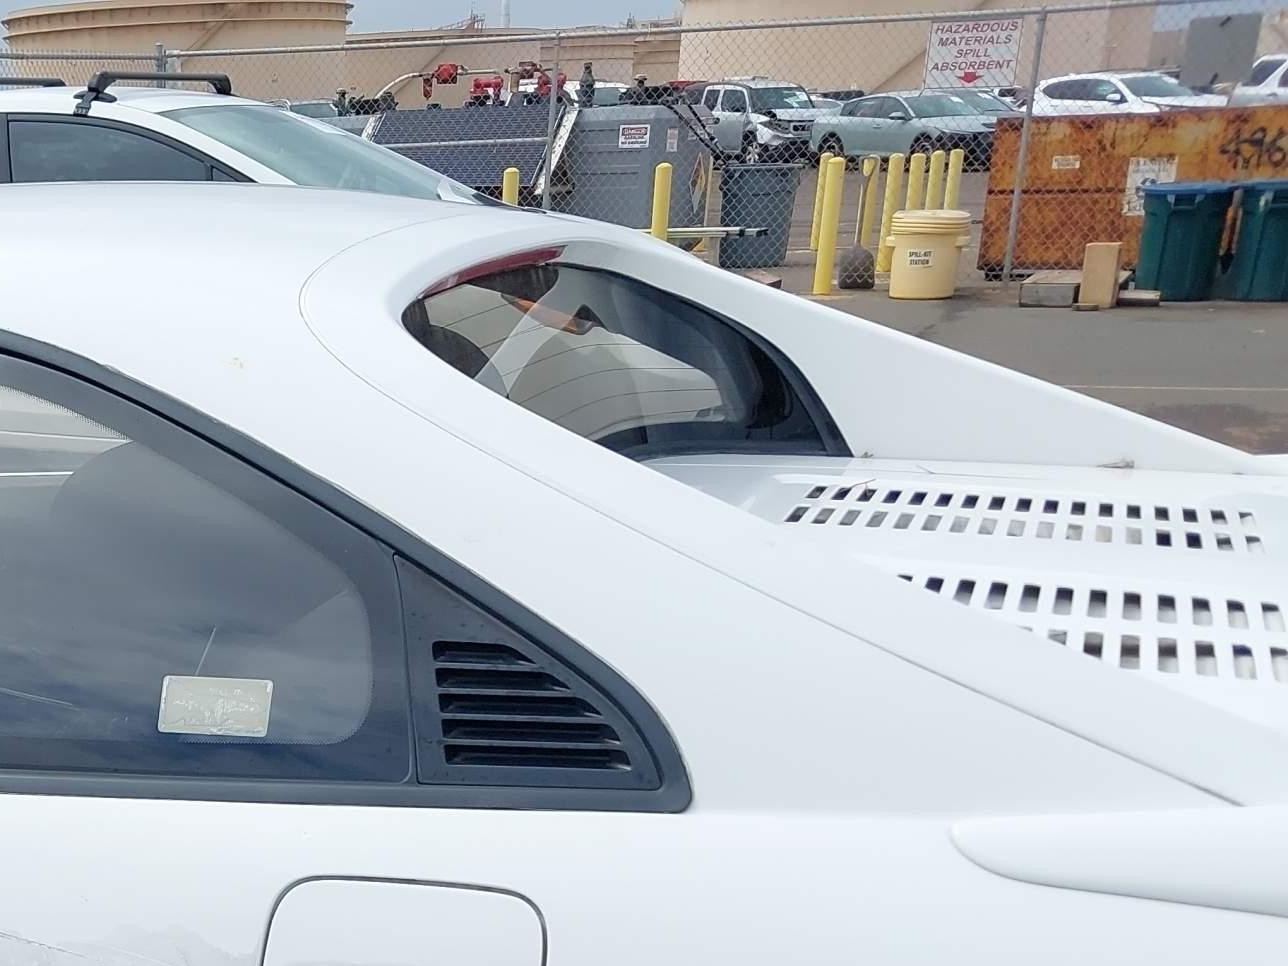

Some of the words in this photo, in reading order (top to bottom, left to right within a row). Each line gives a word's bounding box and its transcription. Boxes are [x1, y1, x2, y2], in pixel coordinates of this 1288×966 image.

[935, 21, 1019, 34] HAZARDOUS
[937, 34, 1013, 46] MATERIALS
[955, 48, 991, 58] SPILL
[931, 60, 1014, 71] ABSORBENT
